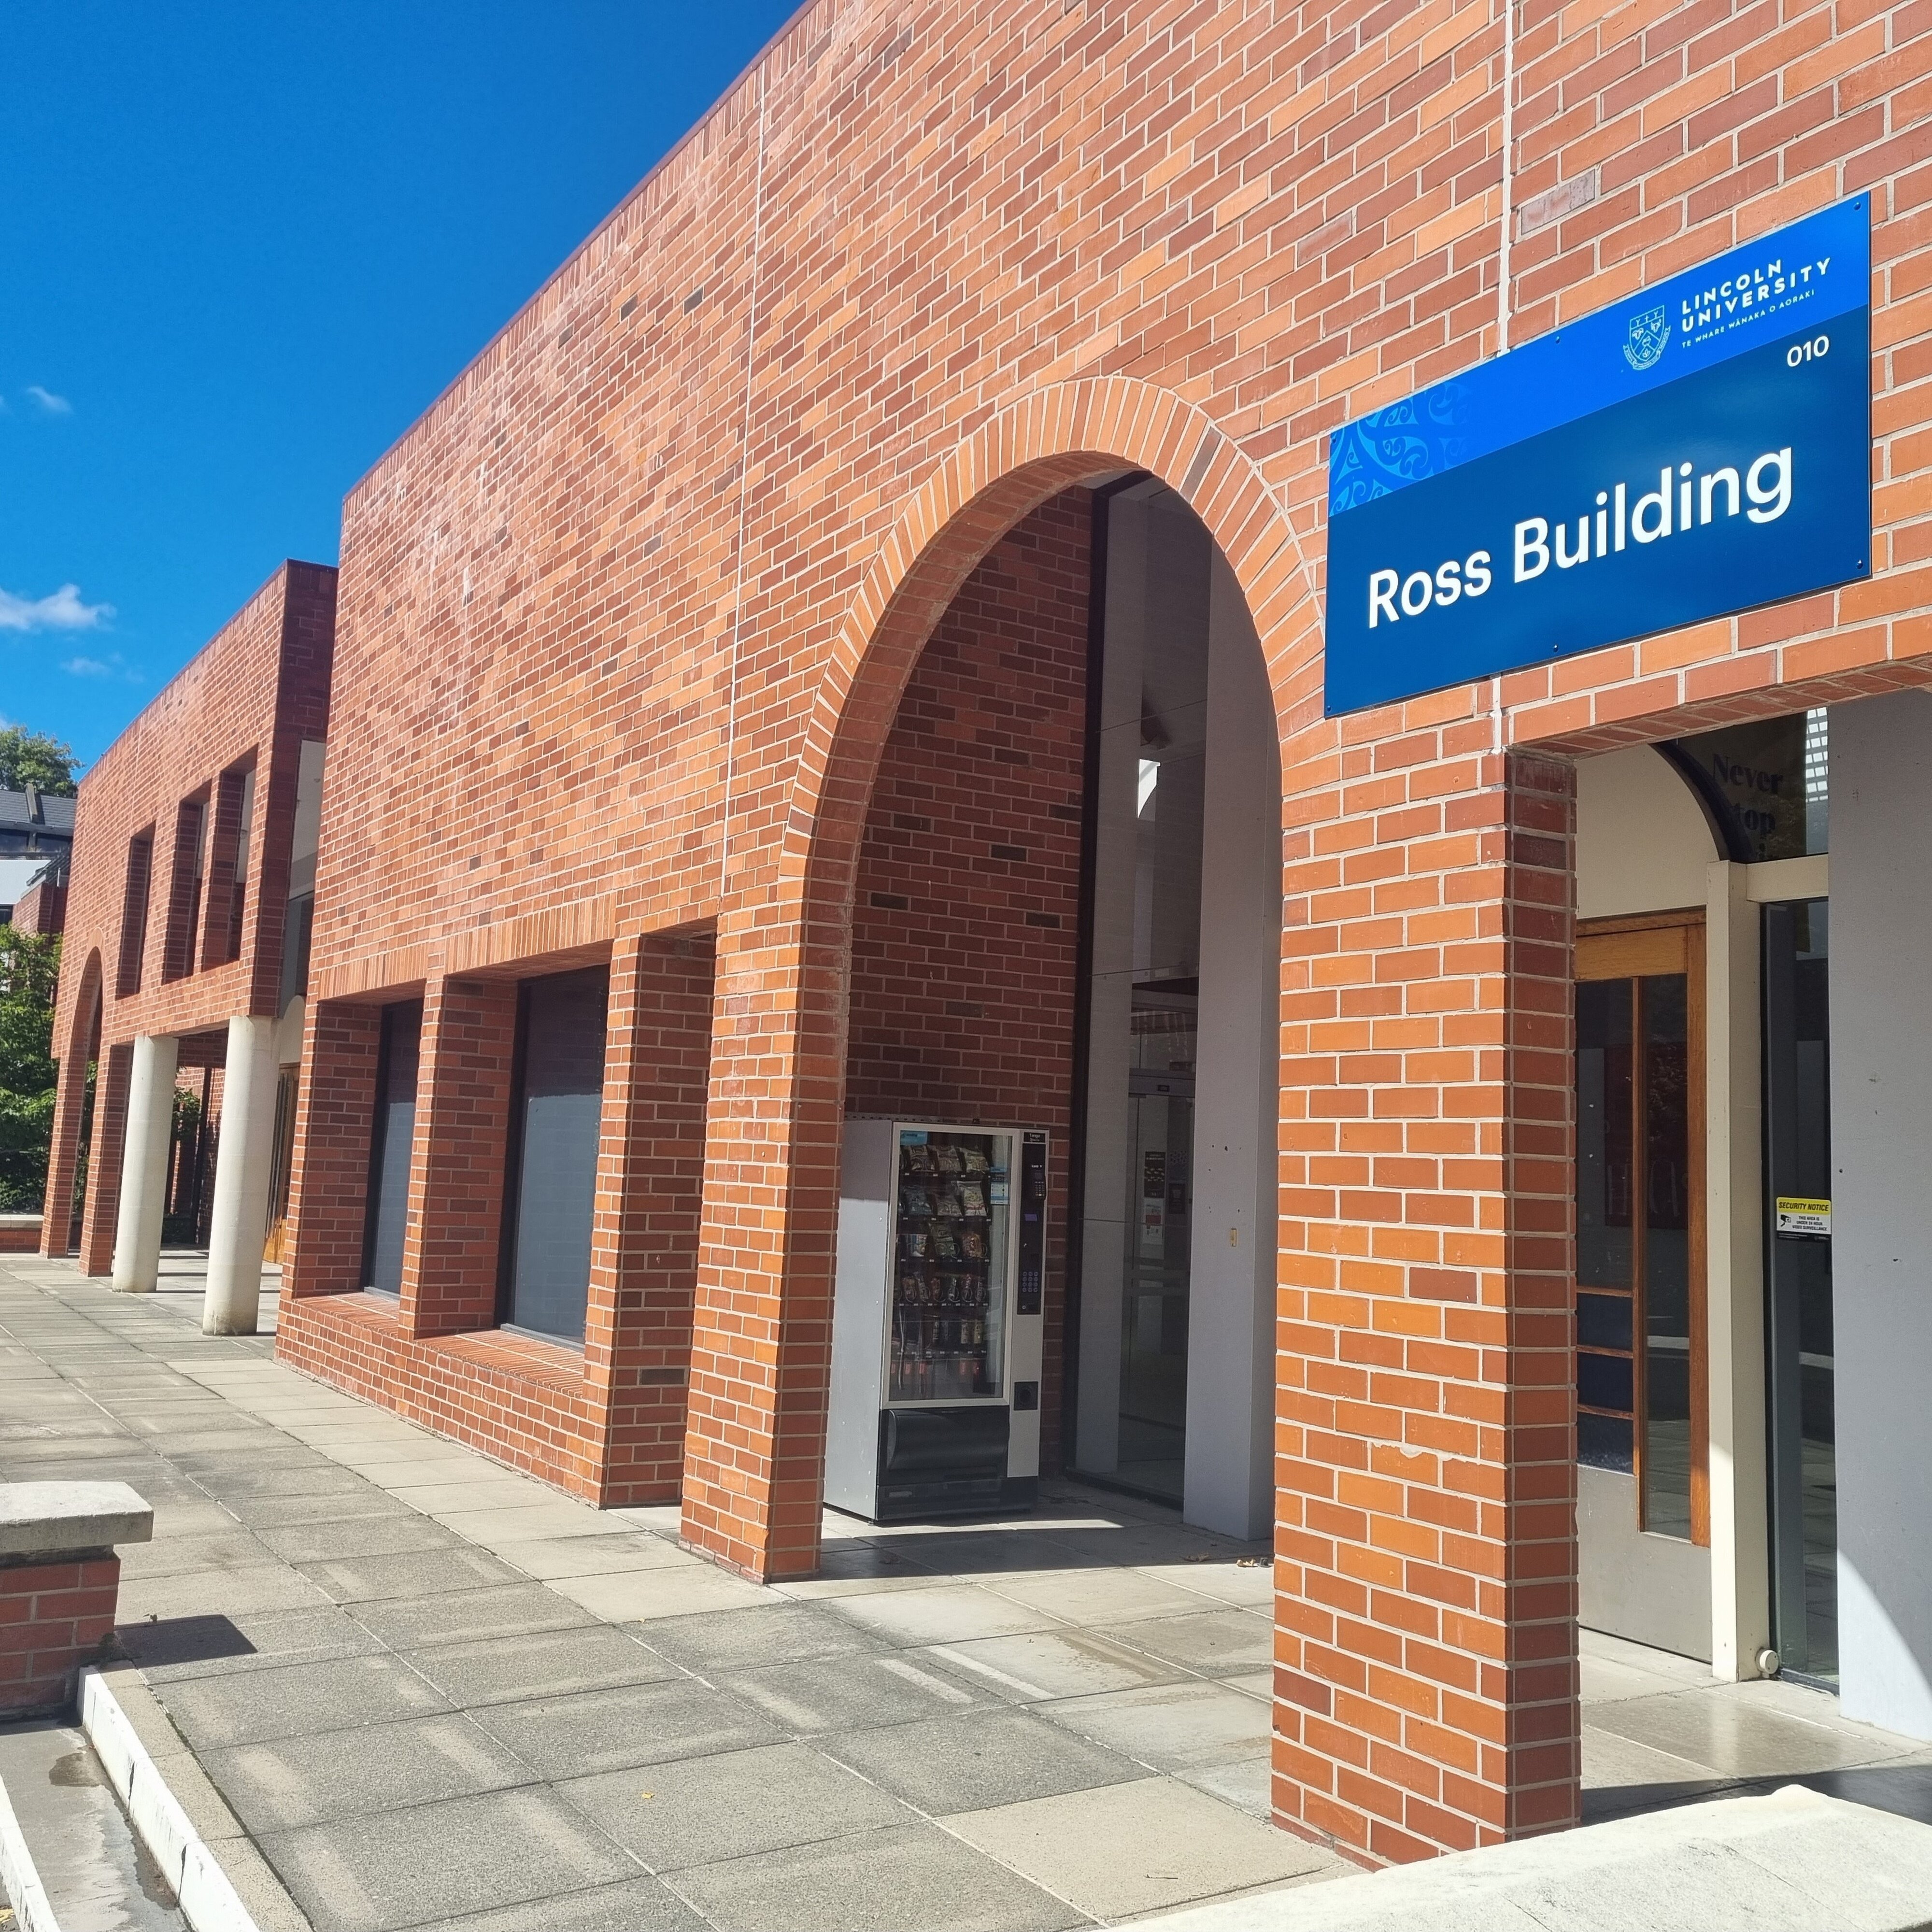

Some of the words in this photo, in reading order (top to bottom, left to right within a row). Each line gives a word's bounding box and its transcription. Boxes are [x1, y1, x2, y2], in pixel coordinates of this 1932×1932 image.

[1681, 259, 1782, 315] LINCOLN
[1681, 257, 1831, 333] UNIVERSITY
[1681, 340, 1691, 349] TE
[1695, 326, 1725, 343] WHARE
[1779, 289, 1815, 310] AORAKI
[1786, 335, 1830, 368] 010
[1368, 550, 1492, 629] Ross
[1513, 446, 1792, 584] Building
[1713, 753, 1783, 794] Never
[1778, 1202, 1806, 1210] SECURITY
[1808, 1203, 1829, 1211] NOTICE
